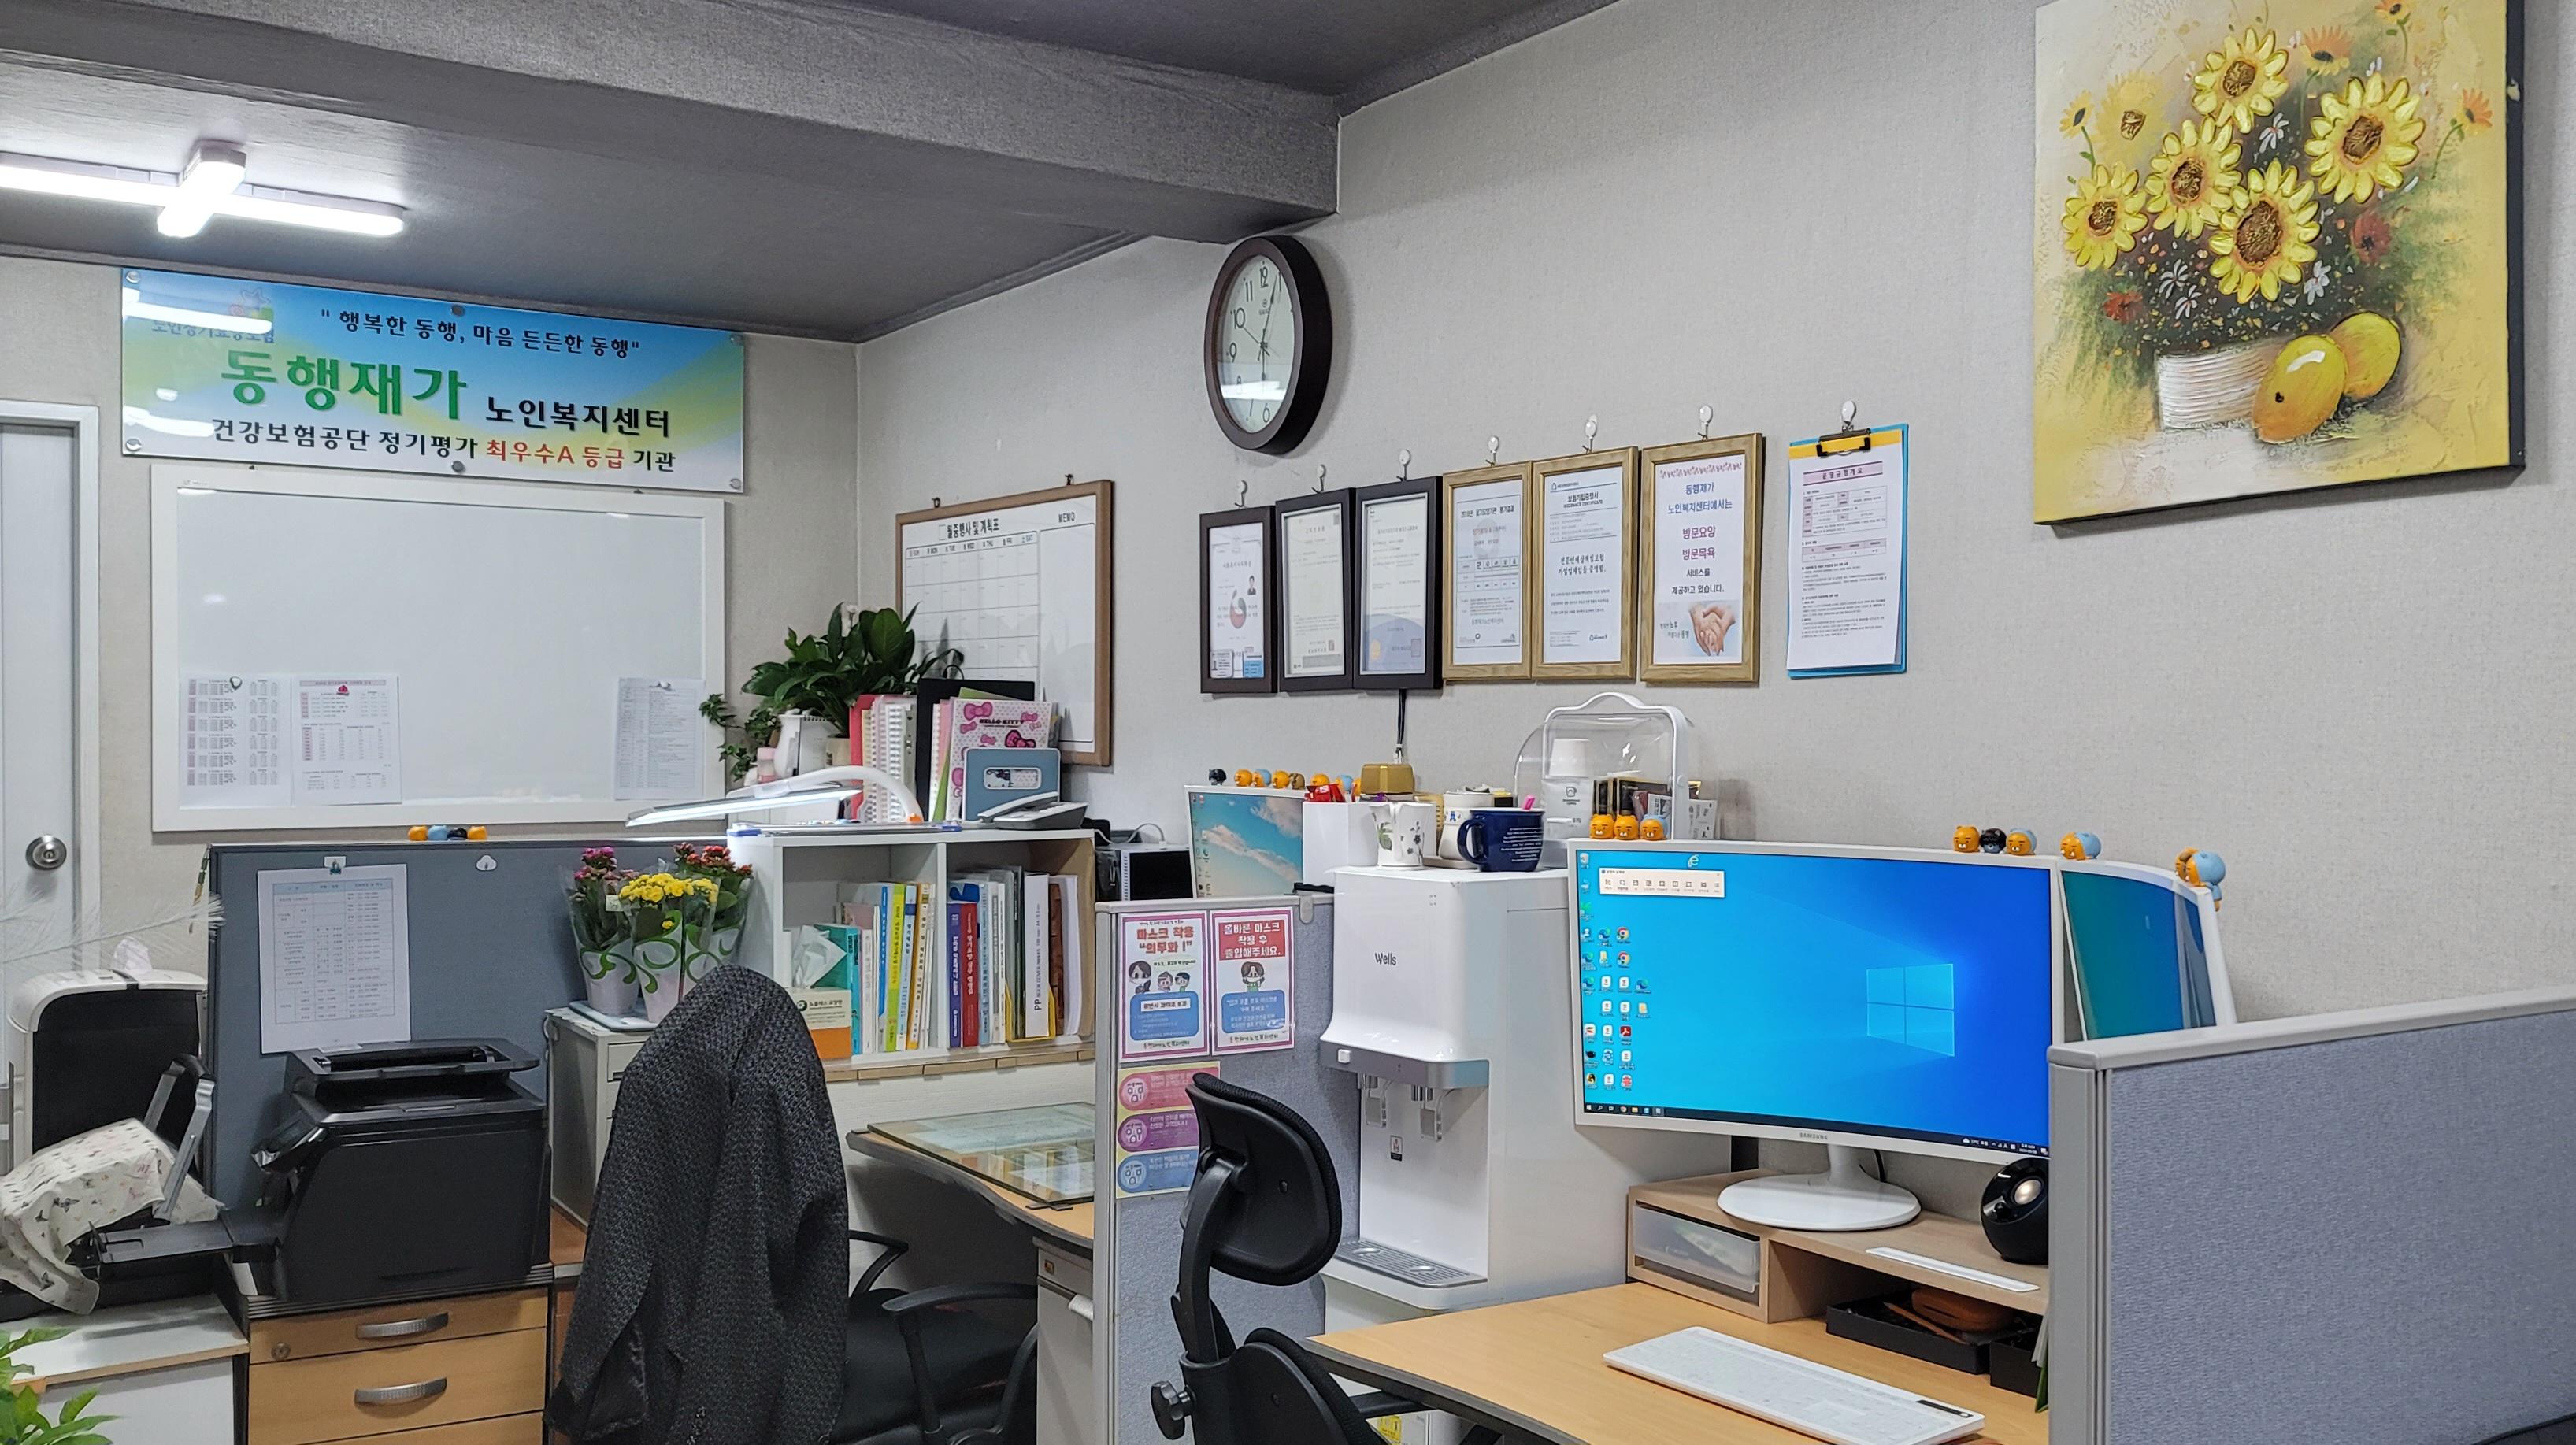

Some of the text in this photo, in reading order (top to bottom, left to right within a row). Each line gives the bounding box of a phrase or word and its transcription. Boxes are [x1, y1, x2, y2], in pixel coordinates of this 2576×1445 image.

[1260, 266, 1269, 288] 12
[1245, 281, 1253, 302] 11
[1233, 308, 1246, 329] 10
[339, 310, 407, 336] 행복한
[414, 319, 465, 343] 동행,
[473, 325, 515, 346] 마음
[523, 330, 583, 354] 든든한
[1229, 343, 1237, 363] 9
[221, 350, 670, 438] 동행재가 노인복지센터
[1262, 403, 1270, 423] 6
[213, 419, 676, 472] 건강보험공단 정기평가 최우수A 등급 기관
[1685, 482, 1714, 495] 동행재가
[1668, 498, 1733, 514] 노인복지센터에서는
[1058, 512, 1076, 523] MEMO
[1682, 525, 1716, 539] 방문요양
[1682, 547, 1715, 561] 방문목욕
[1686, 568, 1710, 577] 서비스를
[1672, 586, 1696, 595] 제공하고
[1137, 928, 1169, 939] 마스크
[1255, 922, 1280, 932] 마스크
[1238, 935, 1255, 946] 착용
[1374, 952, 1397, 966] Wells
